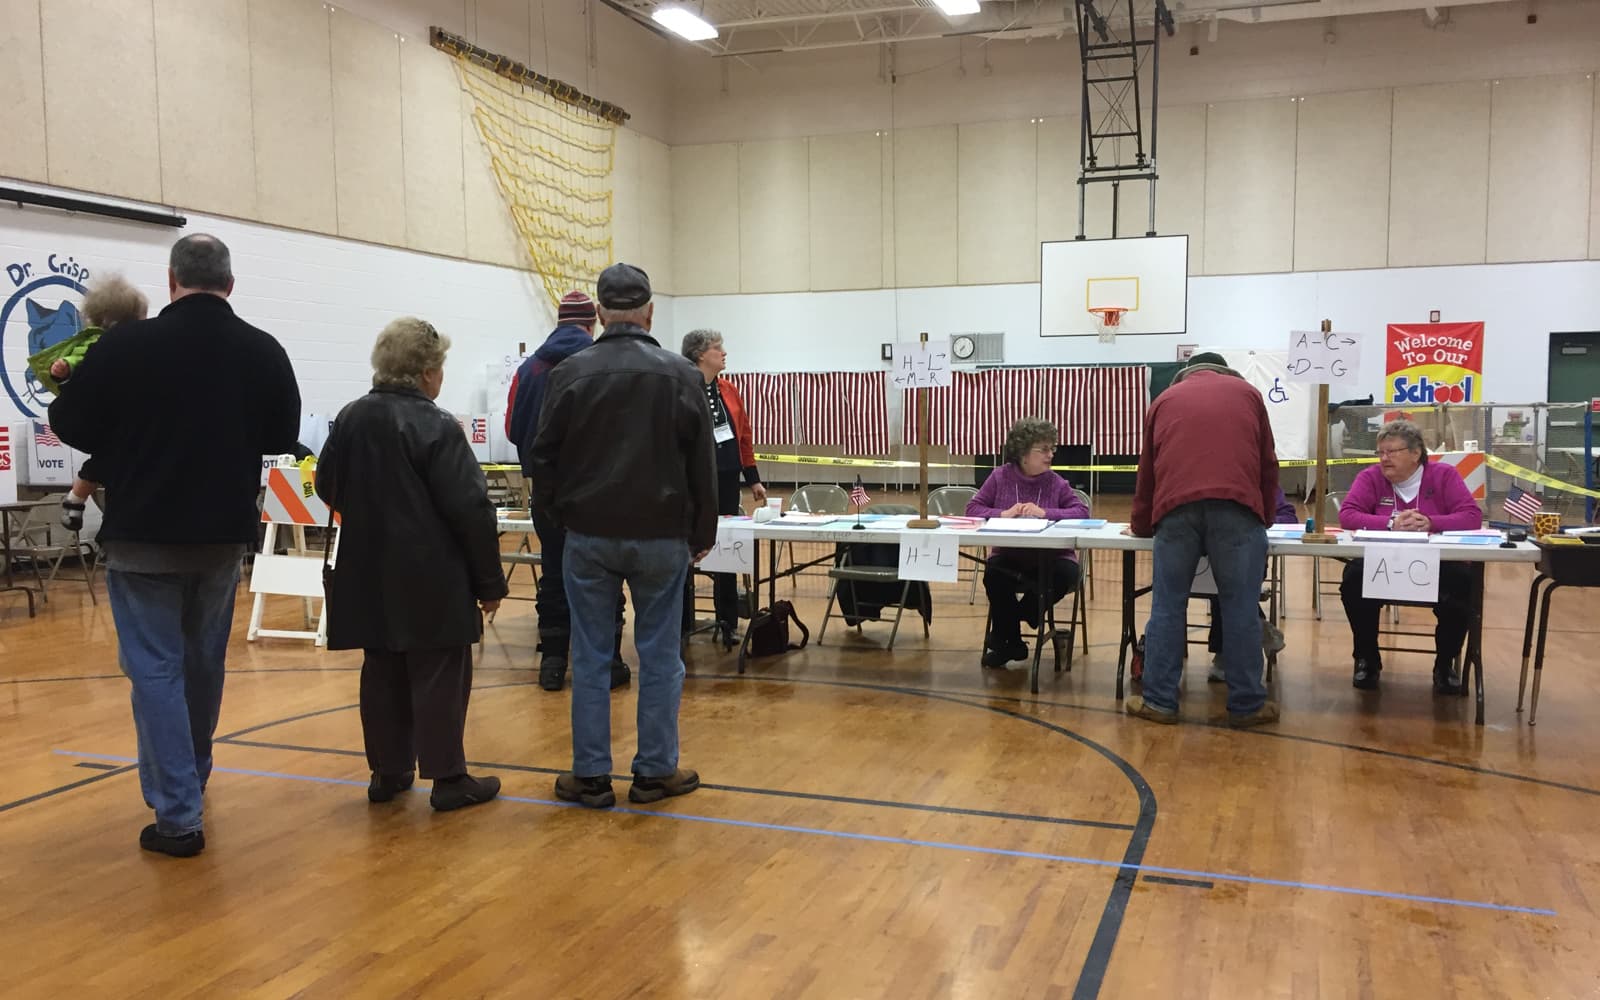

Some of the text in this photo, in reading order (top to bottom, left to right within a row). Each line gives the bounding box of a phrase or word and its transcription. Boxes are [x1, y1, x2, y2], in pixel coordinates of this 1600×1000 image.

[6, 253, 90, 287] Dr. Crisp
[1394, 334, 1473, 353] Welcome
[1402, 349, 1468, 366] To Our
[39, 459, 65, 469] VOTE
